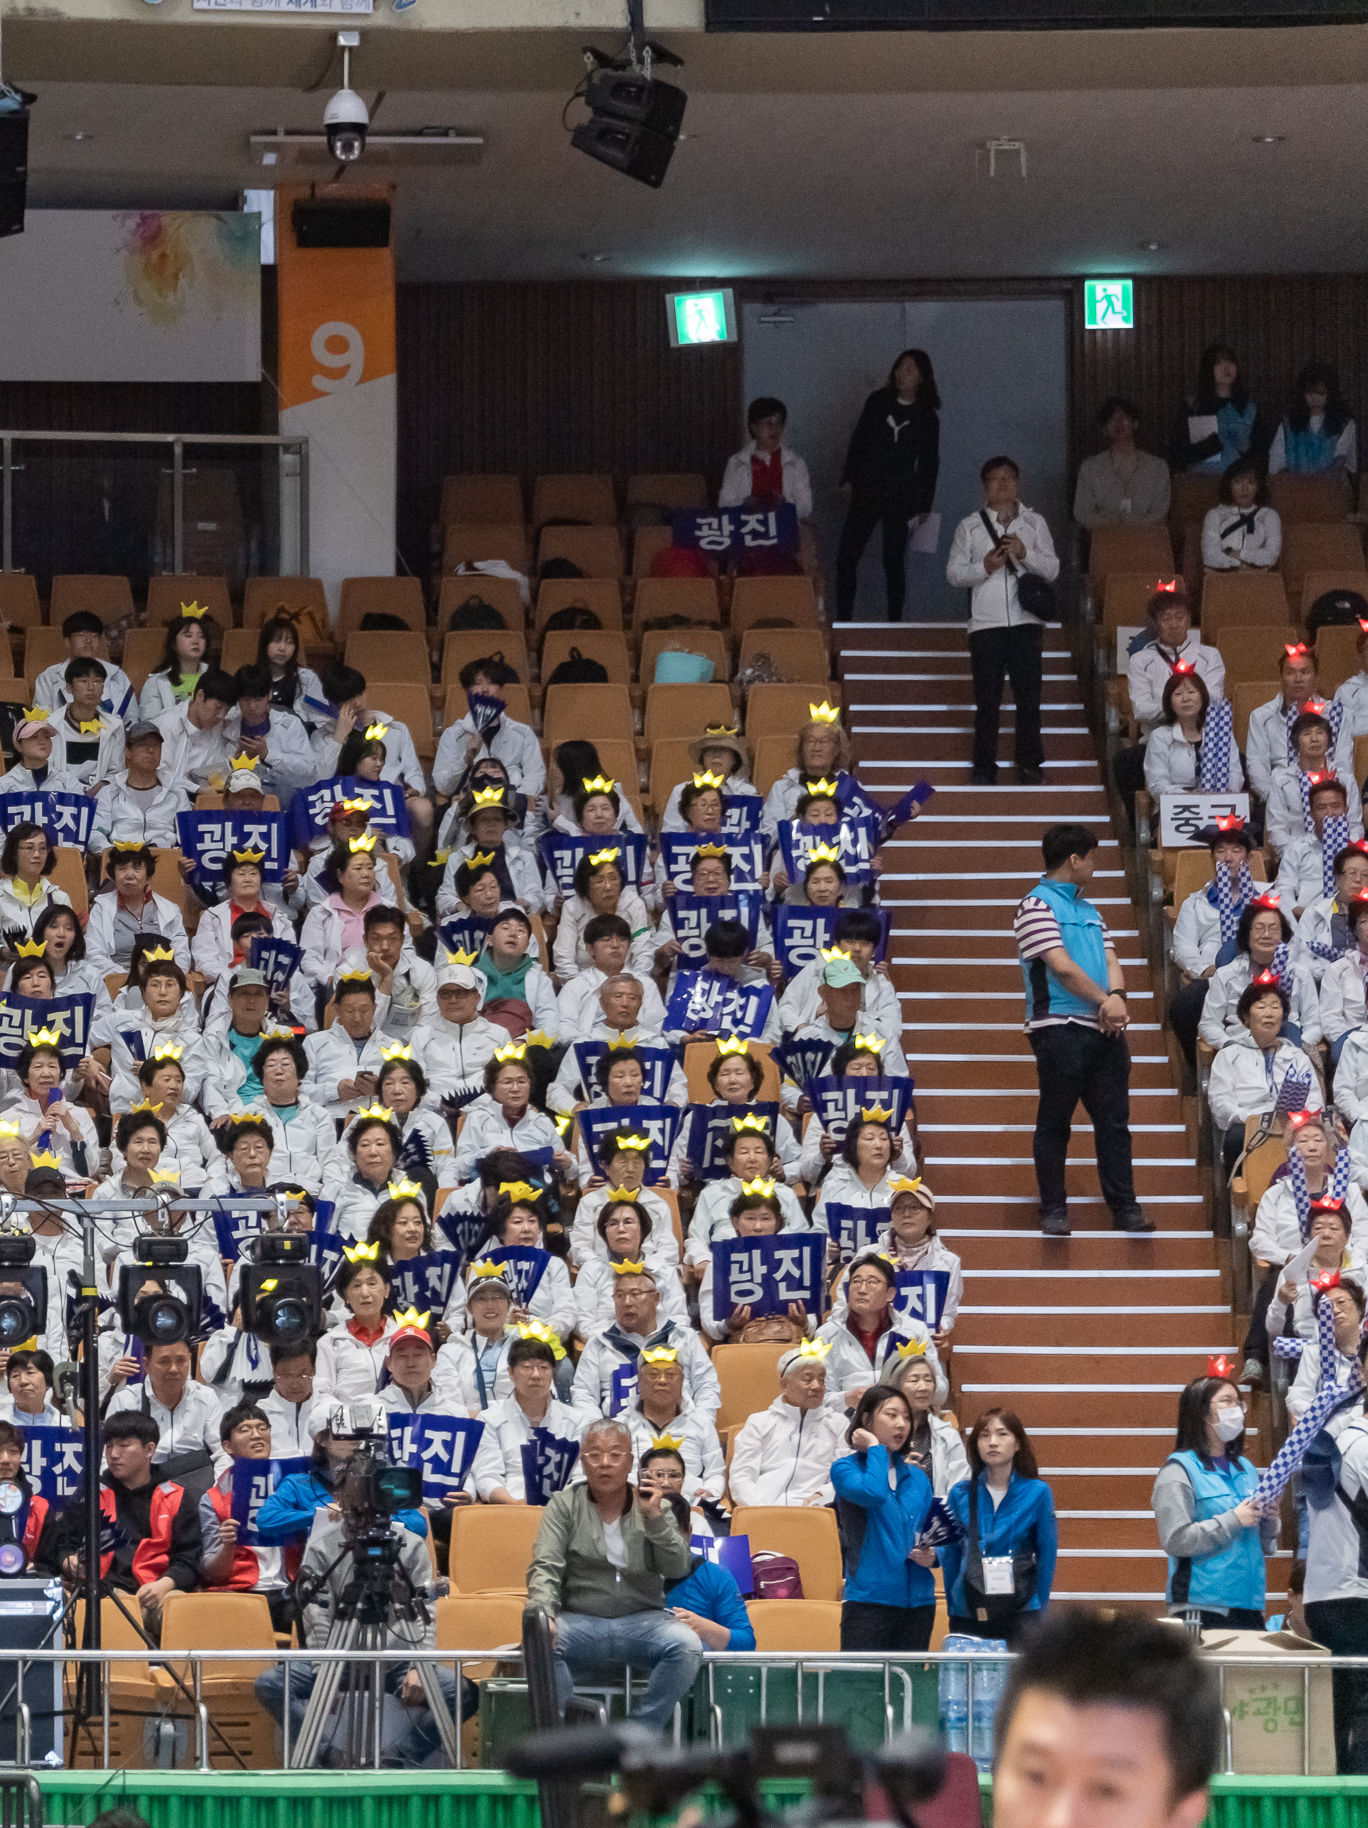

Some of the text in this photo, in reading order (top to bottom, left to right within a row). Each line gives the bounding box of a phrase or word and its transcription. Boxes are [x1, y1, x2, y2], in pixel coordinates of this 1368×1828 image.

[310, 321, 366, 395] 9
[694, 511, 778, 551] 광진
[729, 1247, 812, 1304] 광진
